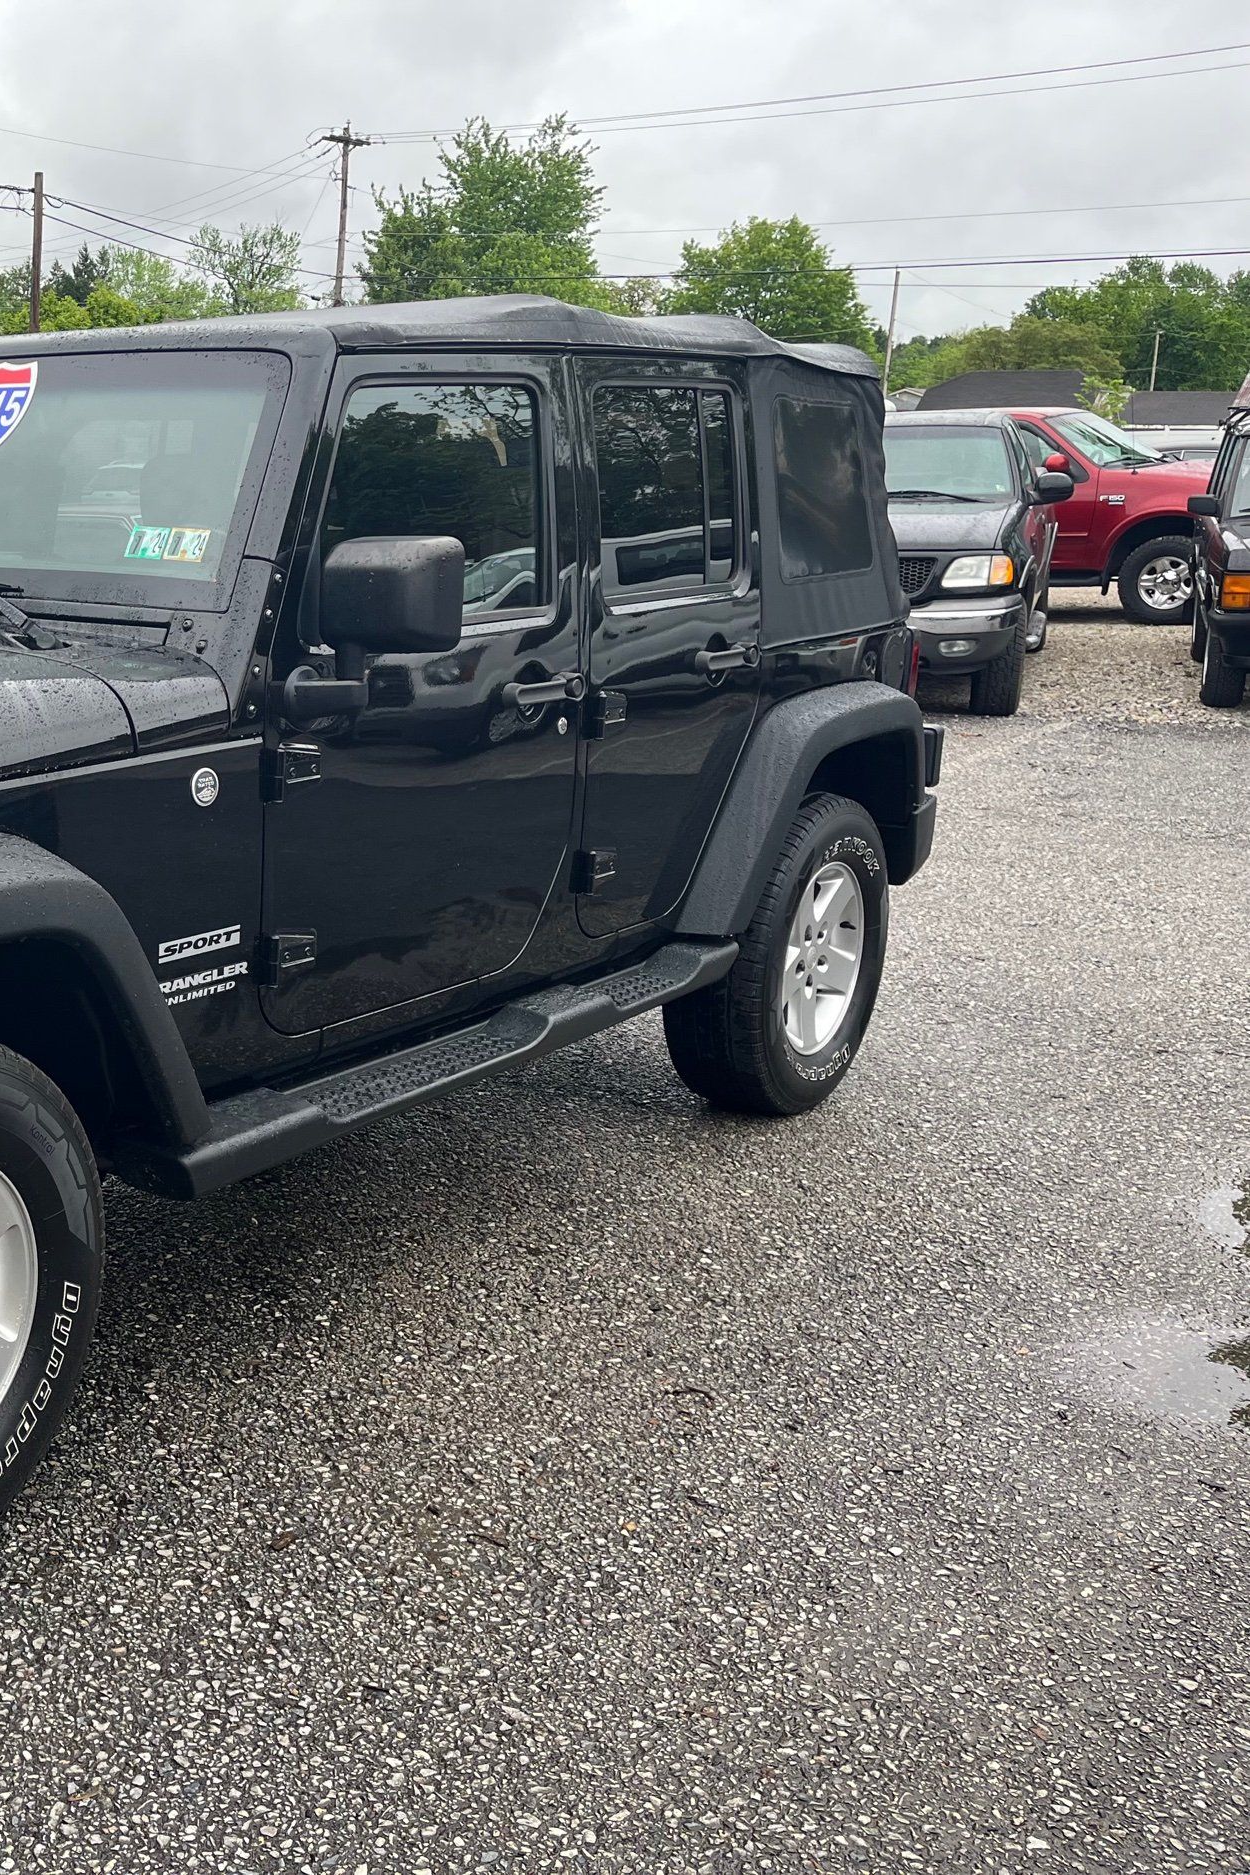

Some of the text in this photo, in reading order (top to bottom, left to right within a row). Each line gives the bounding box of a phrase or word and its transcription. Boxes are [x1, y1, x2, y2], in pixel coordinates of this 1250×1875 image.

[160, 929, 240, 957] SPORT
[158, 961, 249, 993] RANGLER
[30, 1123, 56, 1156] Kontrol
